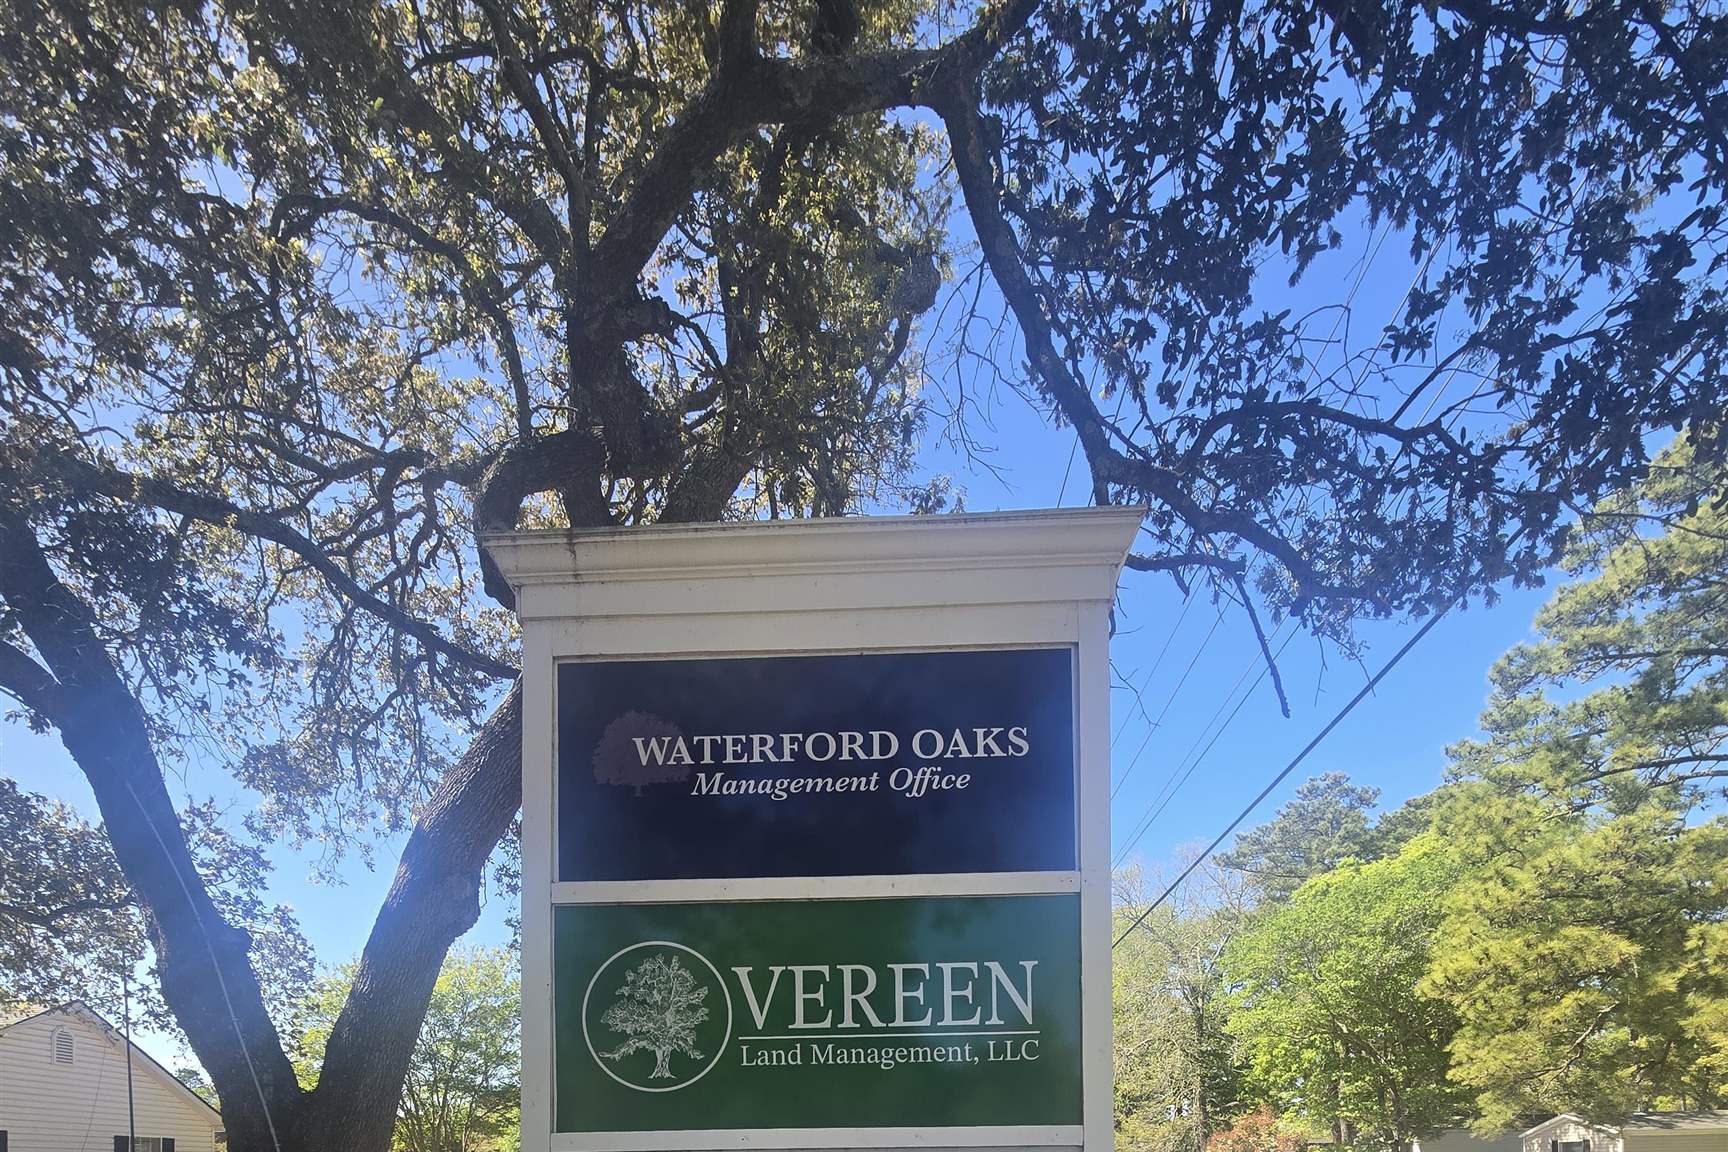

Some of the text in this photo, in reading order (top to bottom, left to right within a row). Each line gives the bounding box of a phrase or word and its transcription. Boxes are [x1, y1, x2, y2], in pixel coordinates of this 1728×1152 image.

[631, 726, 1030, 767] WATERFORD OAKS
[690, 766, 971, 801] Management Office
[730, 960, 1040, 1031] VEREEN
[739, 1039, 1041, 1070] Land Management, LLC
